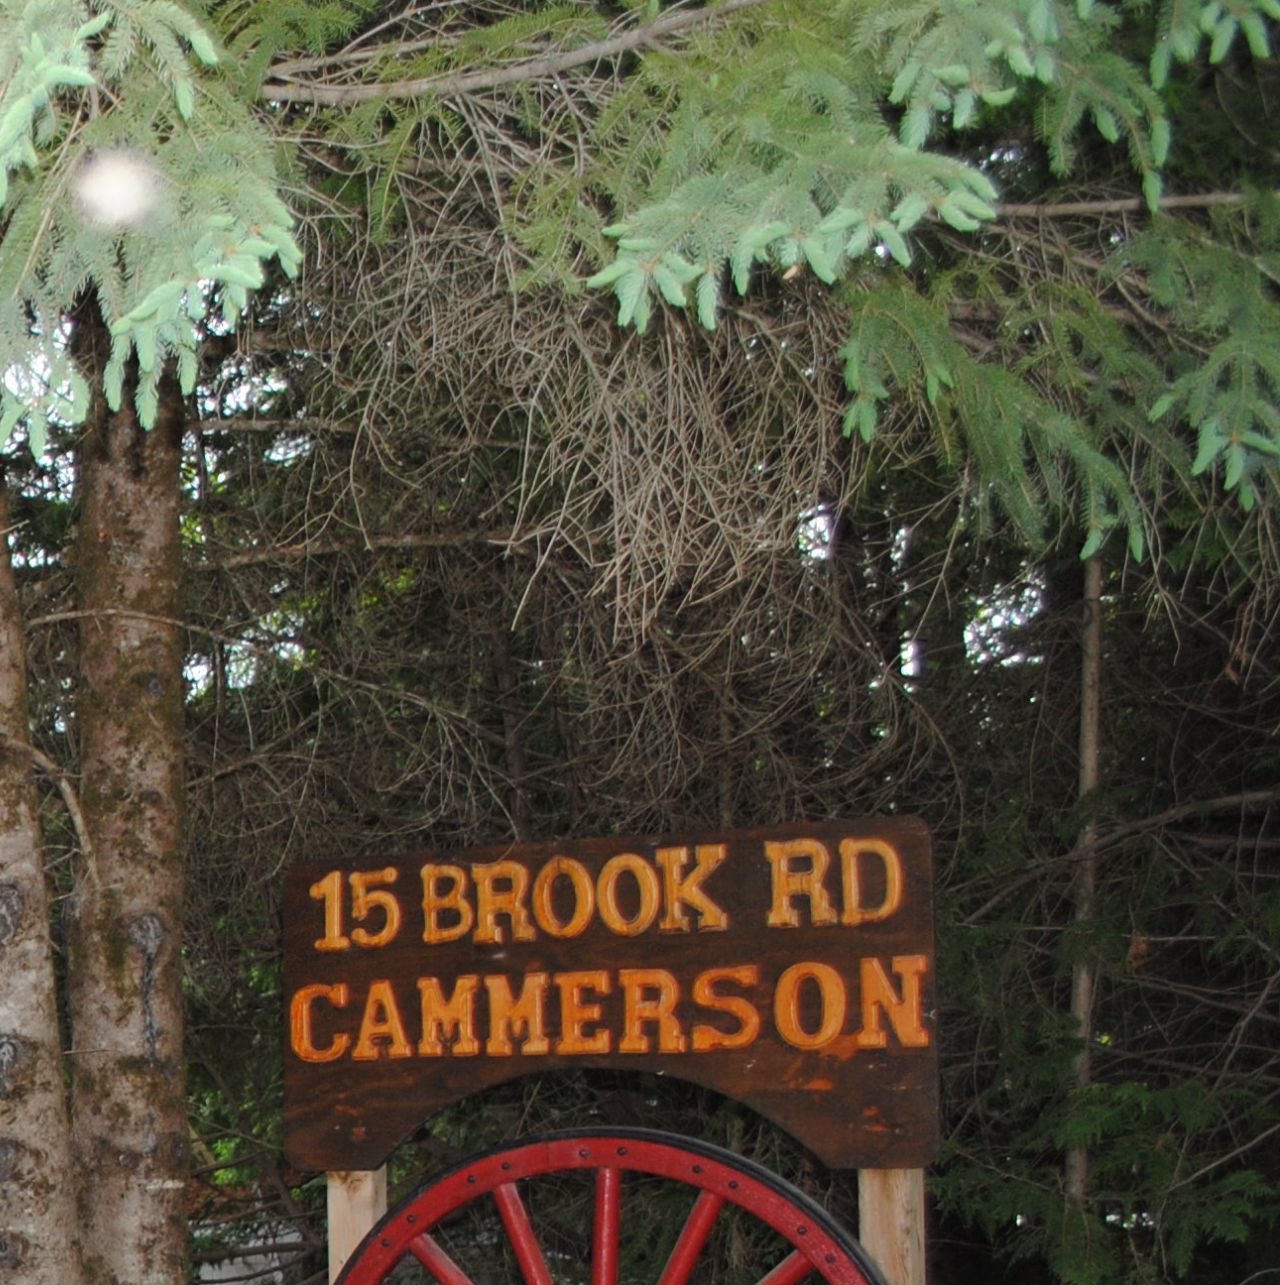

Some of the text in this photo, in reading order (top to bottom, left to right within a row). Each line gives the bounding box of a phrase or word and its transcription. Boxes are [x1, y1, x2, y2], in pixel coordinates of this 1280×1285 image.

[309, 838, 903, 951] 15 BROOK RD
[290, 954, 930, 1063] CAMMERSON
